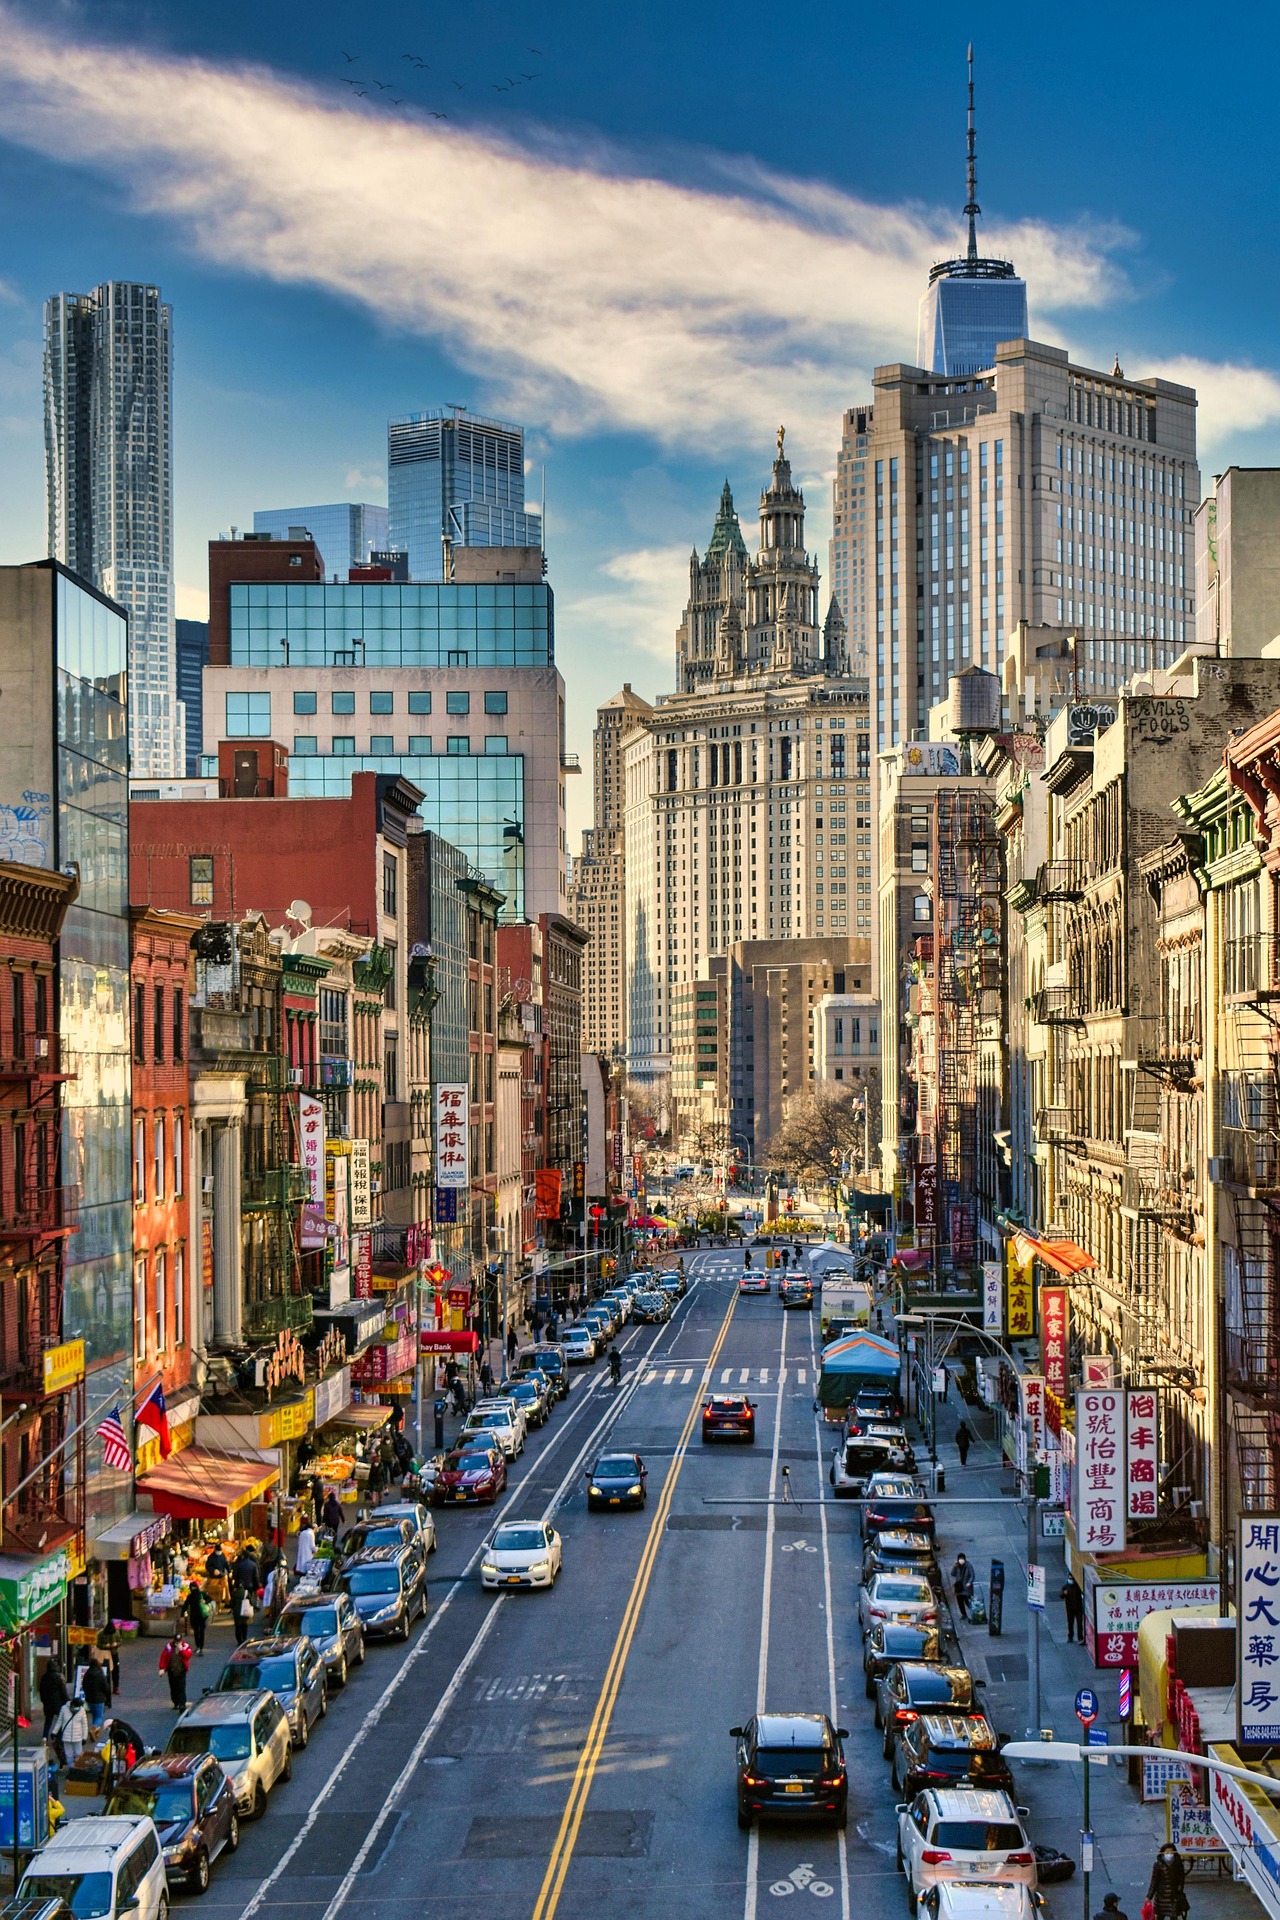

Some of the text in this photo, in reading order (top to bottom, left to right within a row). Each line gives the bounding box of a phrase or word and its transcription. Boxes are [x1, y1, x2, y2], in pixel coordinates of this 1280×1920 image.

[1139, 715, 1190, 733] FOOLS
[1010, 1254, 1031, 1333] 美商場
